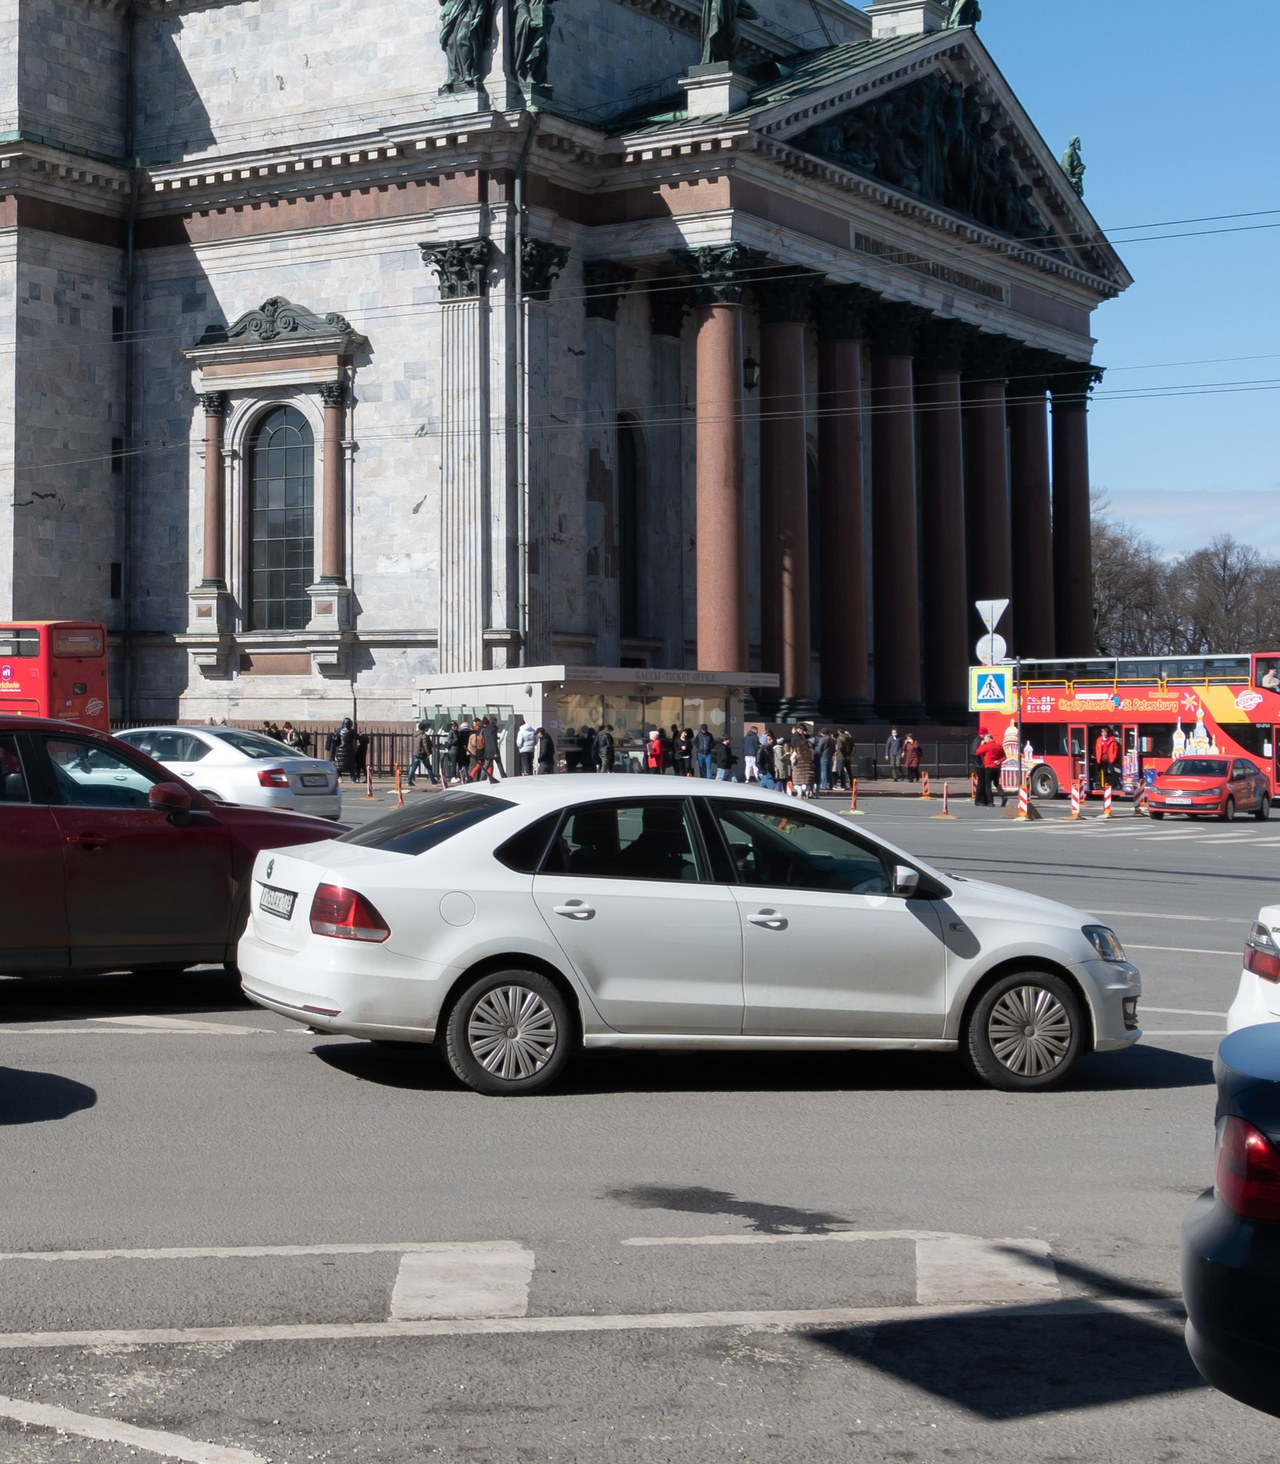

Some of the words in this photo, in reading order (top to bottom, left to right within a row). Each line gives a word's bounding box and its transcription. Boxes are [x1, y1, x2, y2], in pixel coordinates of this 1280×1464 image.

[635, 670, 661, 681] КАССЫ
[665, 672, 691, 682] TICKET
[693, 673, 717, 683] OFFICE
[1133, 698, 1179, 713] Petersburg
